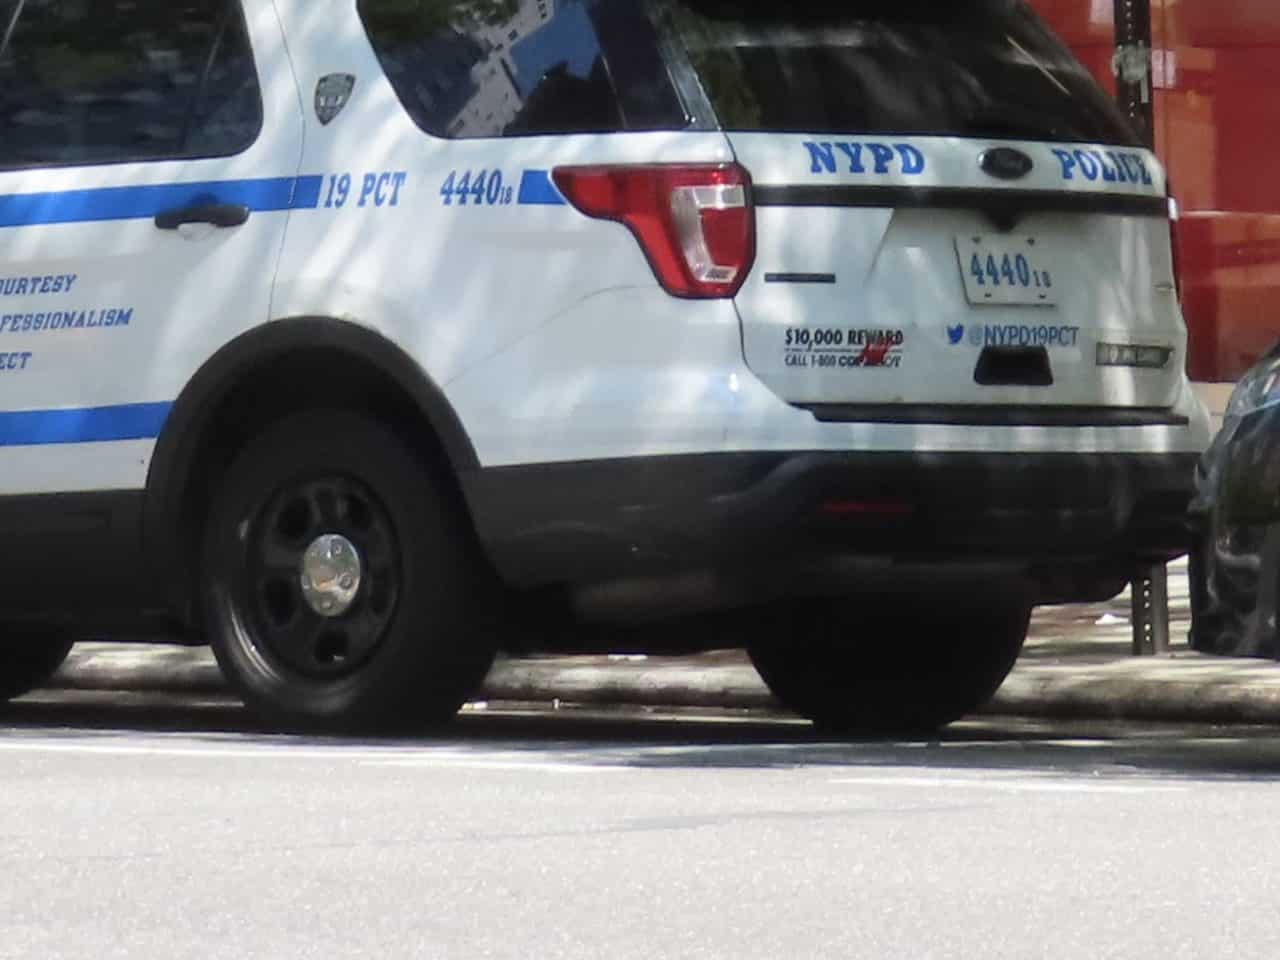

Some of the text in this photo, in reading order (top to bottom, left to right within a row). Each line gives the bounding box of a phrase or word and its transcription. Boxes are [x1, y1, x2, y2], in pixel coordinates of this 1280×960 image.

[801, 141, 925, 174] NYPD
[1051, 149, 1153, 185] POLICE
[323, 171, 407, 208] 19 PCT
[785, 327, 904, 351] $10,000 REWARD
[969, 324, 1080, 348] @NYPD19PCT
[785, 355, 808, 368] CALL
